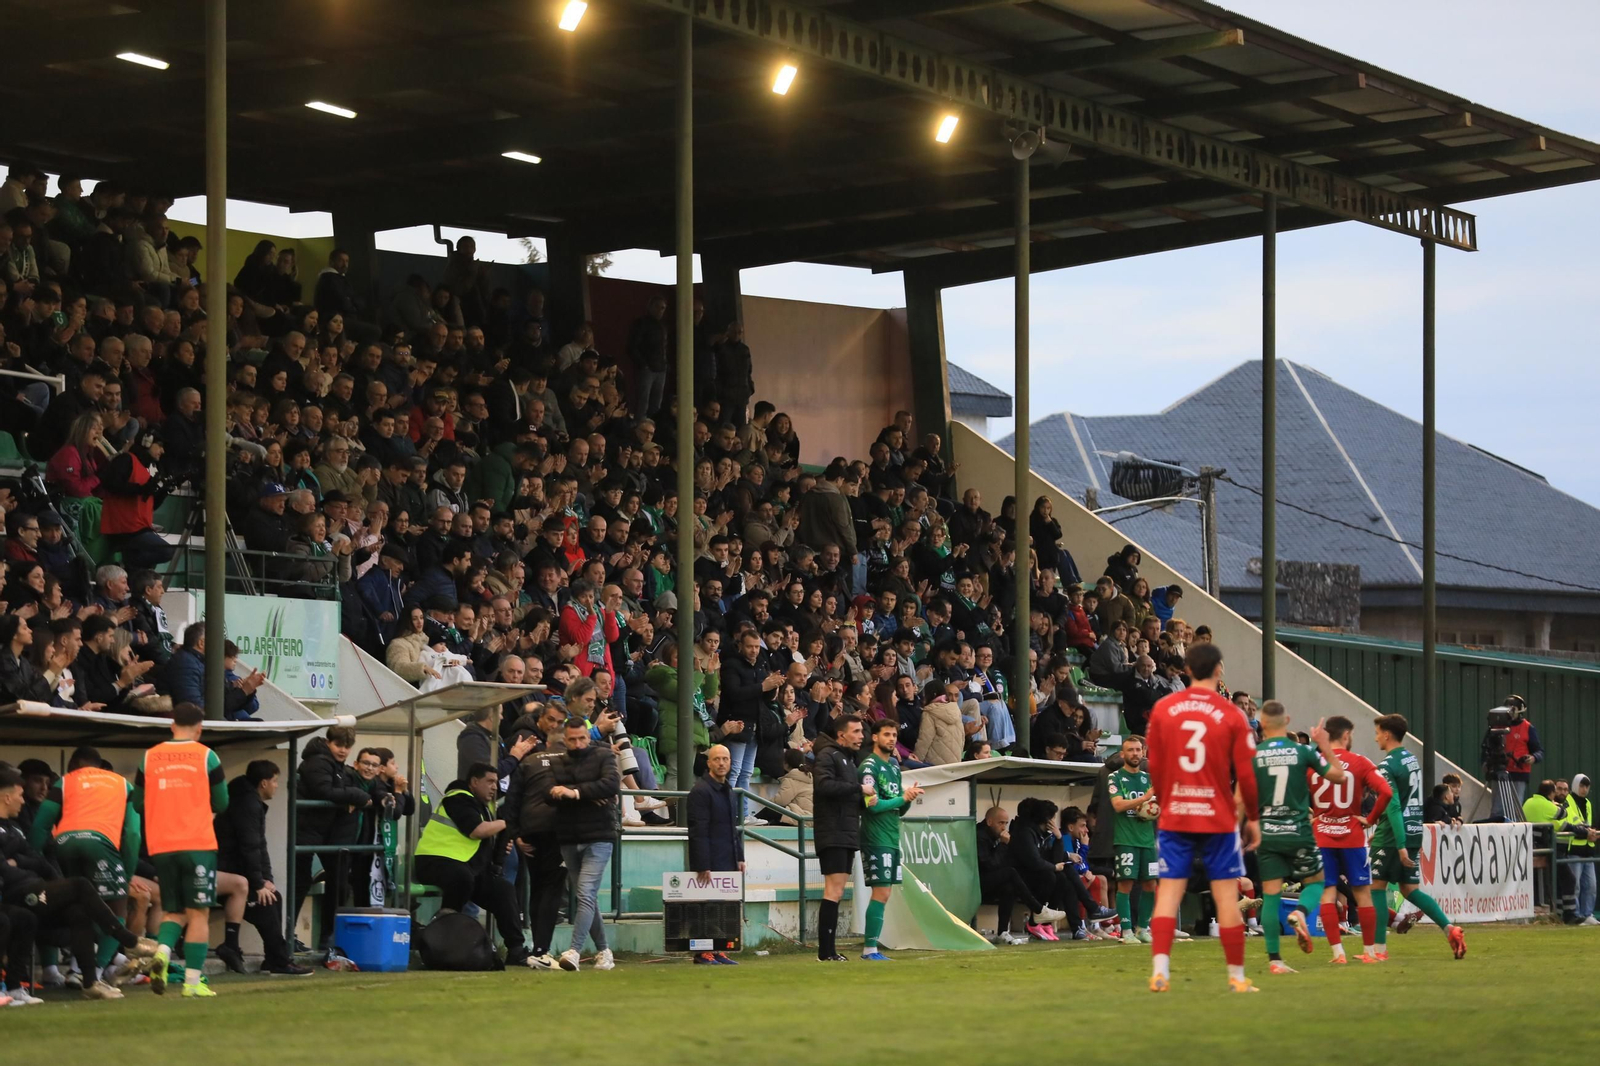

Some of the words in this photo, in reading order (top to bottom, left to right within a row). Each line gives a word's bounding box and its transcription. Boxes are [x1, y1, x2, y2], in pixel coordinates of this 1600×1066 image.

[254, 636, 303, 657] ARENTEIRO
[1168, 701, 1214, 717] CHECHU
[1178, 720, 1207, 773] 3
[1268, 766, 1289, 806] 7
[1311, 770, 1355, 809] 20
[1407, 770, 1423, 806] 21
[882, 853, 892, 867] 16
[1121, 852, 1134, 866] 22
[1439, 824, 1528, 885] cadavid
[1464, 892, 1474, 914] de
[1476, 888, 1529, 914] construcción
